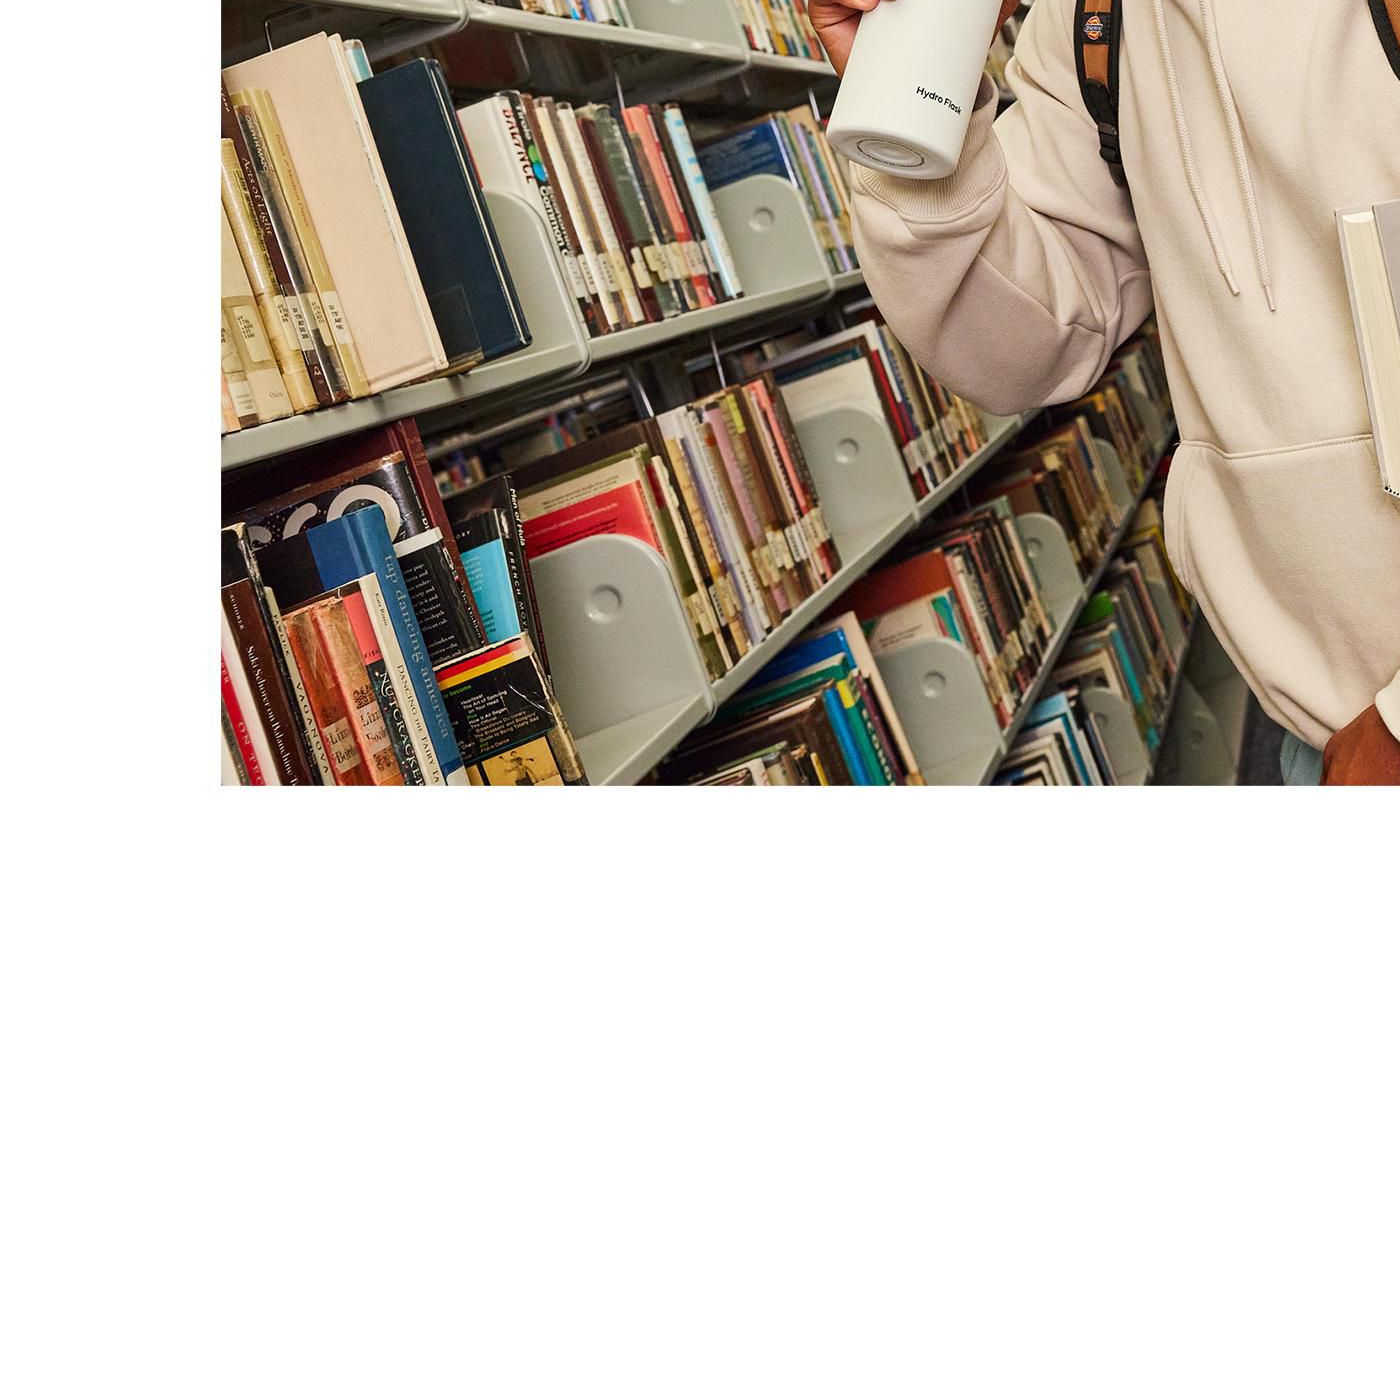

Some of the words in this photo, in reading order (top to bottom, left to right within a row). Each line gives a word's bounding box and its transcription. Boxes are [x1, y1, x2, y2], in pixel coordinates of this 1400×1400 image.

[916, 86, 944, 104] Hydro
[944, 98, 962, 115] Flask
[241, 155, 257, 184] Acts
[251, 186, 263, 201] of
[254, 201, 275, 238] Light
[538, 184, 565, 247] Common
[510, 488, 518, 508] Men
[516, 523, 526, 546] Hula
[378, 553, 402, 585] tap
[508, 551, 521, 595] FRENCH
[387, 587, 430, 664] dancing
[244, 644, 261, 669] Suki
[250, 667, 274, 707] Schorer
[415, 666, 453, 739] america
[264, 707, 276, 722] on
[289, 681, 335, 774] VAGANOVA
[393, 663, 421, 716] DANCING
[419, 736, 437, 766] FAIRY
[267, 721, 298, 774] Balanchine
